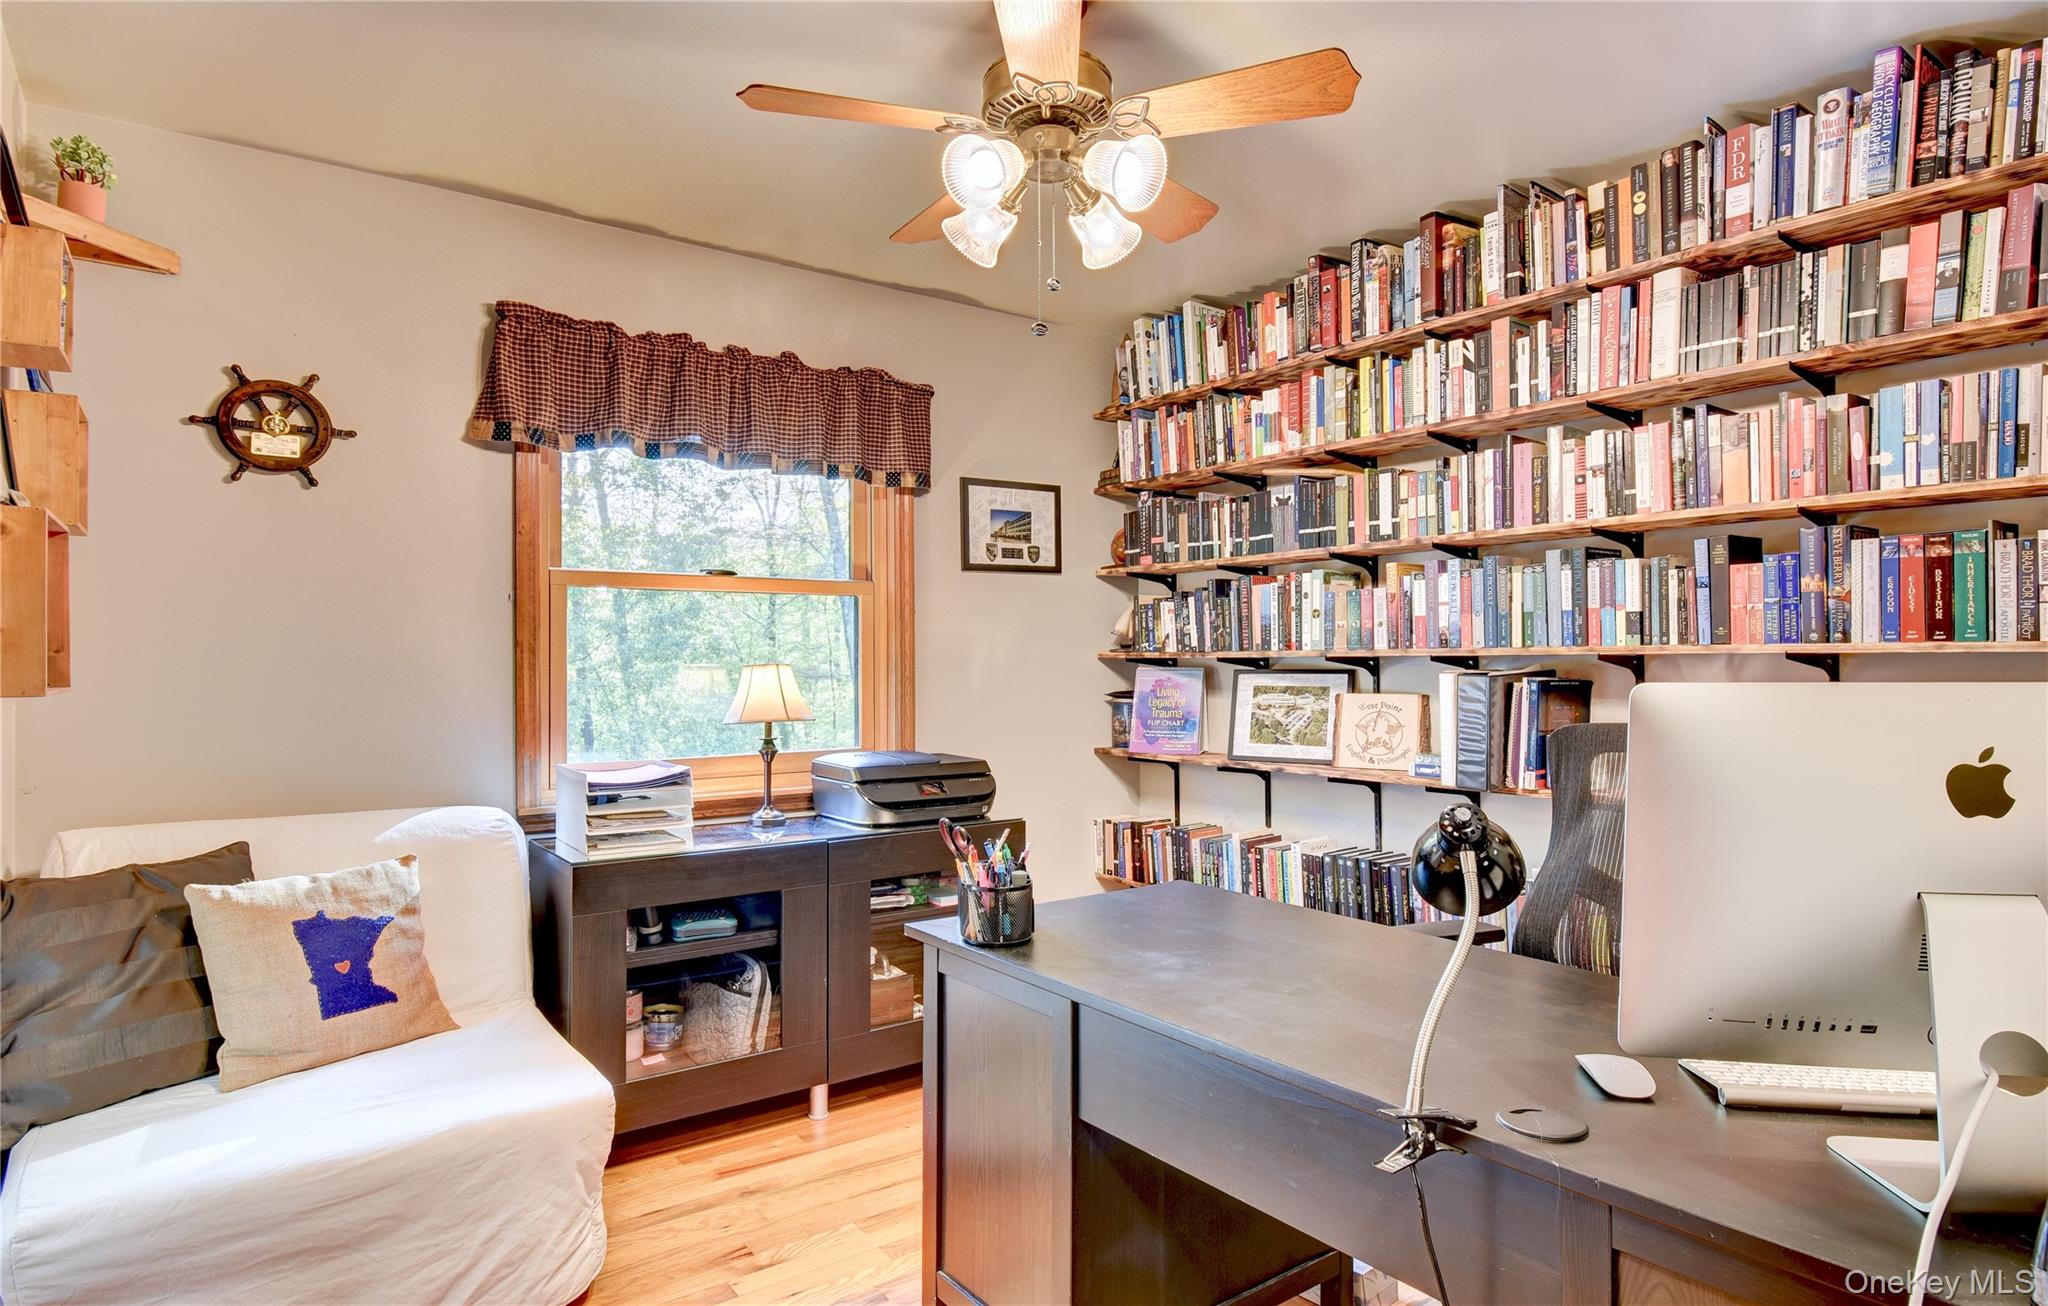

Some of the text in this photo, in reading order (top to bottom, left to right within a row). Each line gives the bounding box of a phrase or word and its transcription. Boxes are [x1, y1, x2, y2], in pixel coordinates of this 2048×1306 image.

[2022, 51, 2035, 122] EXTREME OWNERSHIP
[1868, 63, 1886, 155] WORLD GEOGRAPHY
[1881, 63, 1896, 153] ENCYCLOPEDIA OF
[1920, 98, 1937, 140] PIRATES
[1683, 146, 1692, 178] AMERICAN
[1731, 136, 1746, 180] FDR
[2006, 193, 2019, 261] ANTHOLOGY POETRY
[2021, 215, 2029, 241] NORTON
[1351, 246, 1361, 270] SECOND
[1422, 229, 1431, 269] HOLOCAUST
[1567, 254, 1576, 272] 1776
[1351, 270, 1361, 295] WORLD
[1591, 300, 1601, 326] IDIOT
[1605, 308, 1615, 336] ANGELS
[1606, 349, 1615, 378] DEMONS
[2003, 420, 2014, 446] BANJO
[1832, 528, 1844, 587] STEVE BERRY
[1767, 566, 1775, 581] STEVE
[1785, 565, 1793, 598] STEVE BERRY
[2000, 551, 2012, 600] BRAD THOR
[2022, 550, 2034, 599] BRAD THOR
[1486, 577, 1495, 606] PICOULT
[1887, 576, 1895, 613] ERAGON
[1907, 575, 1915, 613] ELDEST
[1934, 568, 1943, 620] BRISINGR
[1966, 556, 1975, 627] INHERITANCE
[2000, 609, 2009, 640] APOSTLE
[2021, 608, 2031, 639] PATRIOT
[1148, 697, 1186, 709] Legacy of
[1156, 687, 1180, 698] Living
[1358, 701, 1403, 713] West Point
[1151, 708, 1183, 718] Trauma
[1368, 757, 1376, 765] &
